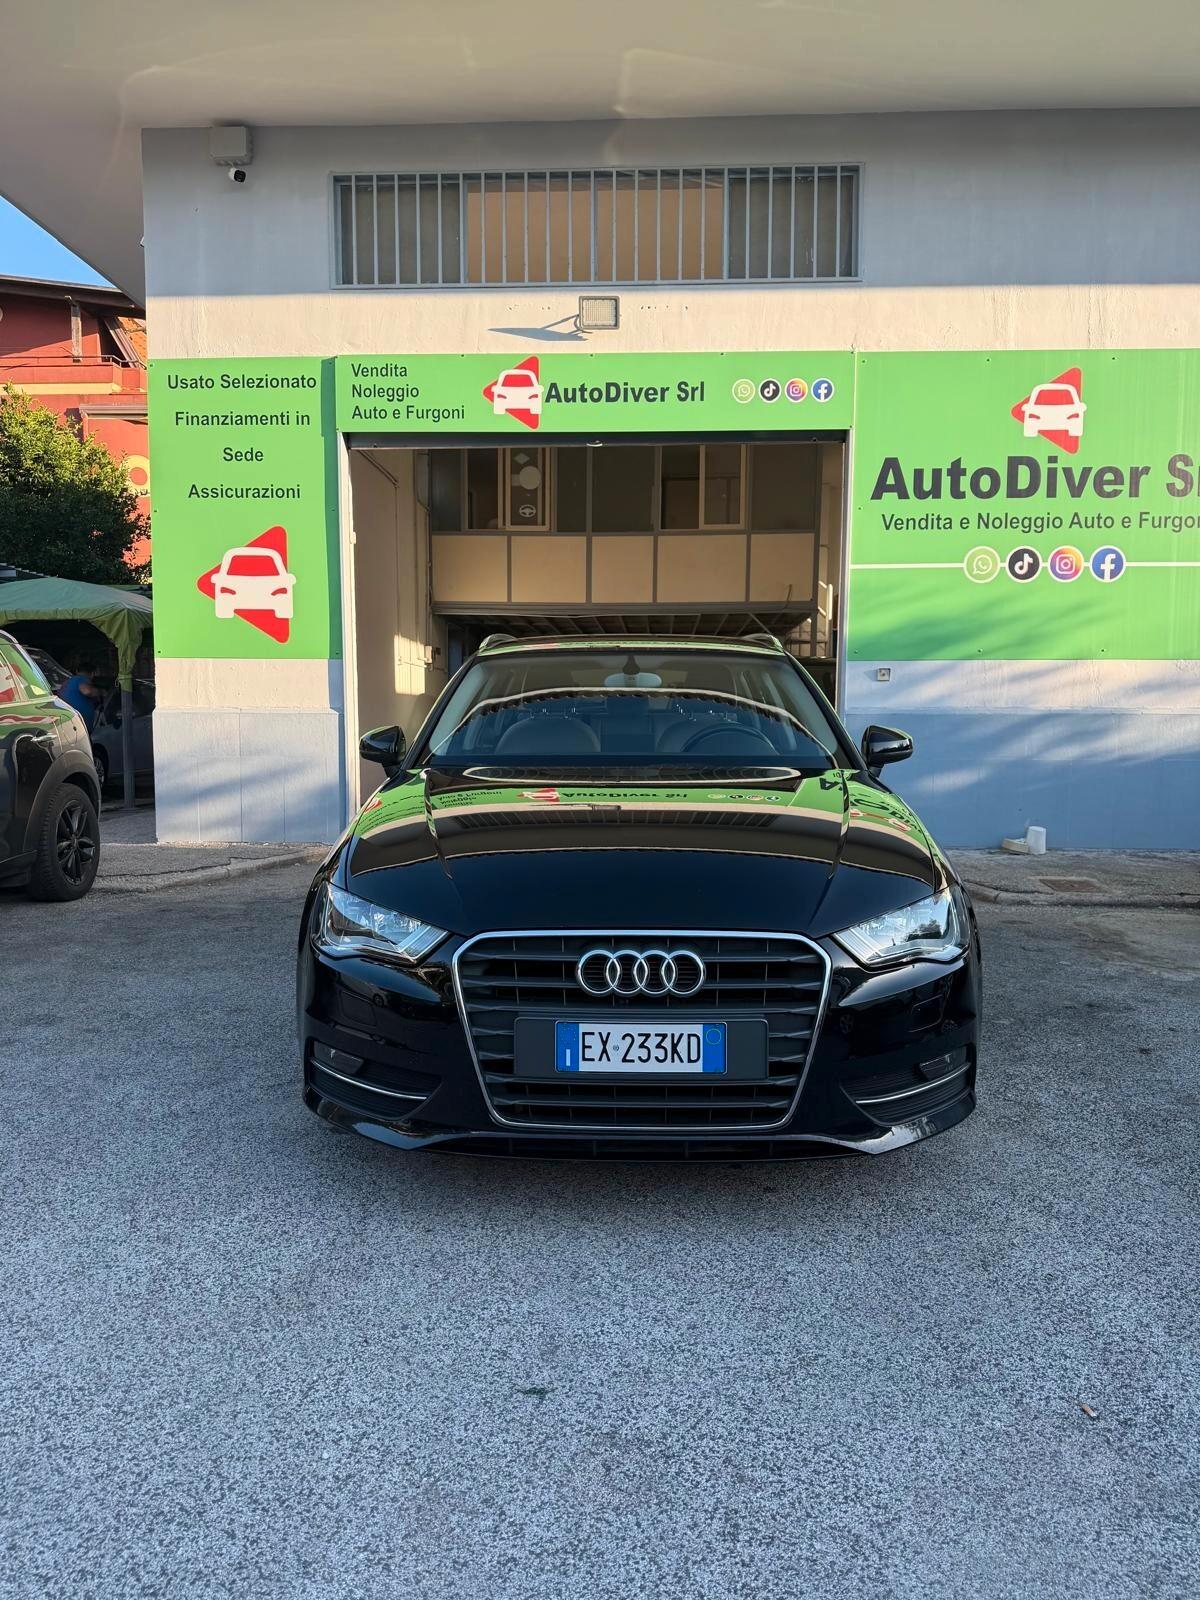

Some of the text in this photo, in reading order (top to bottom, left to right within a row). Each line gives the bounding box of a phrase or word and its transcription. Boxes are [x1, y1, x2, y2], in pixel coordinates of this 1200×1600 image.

[351, 364, 407, 377] Vendita
[168, 374, 316, 389] Usato Selezionato
[351, 384, 419, 401] Noleggio
[545, 381, 704, 403] AutoDiver Srl
[176, 411, 309, 425] Finanziamenti in
[352, 405, 464, 422] Auto e Furgoni
[223, 447, 263, 461] Sede
[871, 454, 1200, 500] AutoDiver S
[189, 484, 300, 498] Assicurazioni
[882, 512, 1200, 533] Vendita e Noleggio Auto e Furgo
[565, 1031, 701, 1067] I EX 233KD
